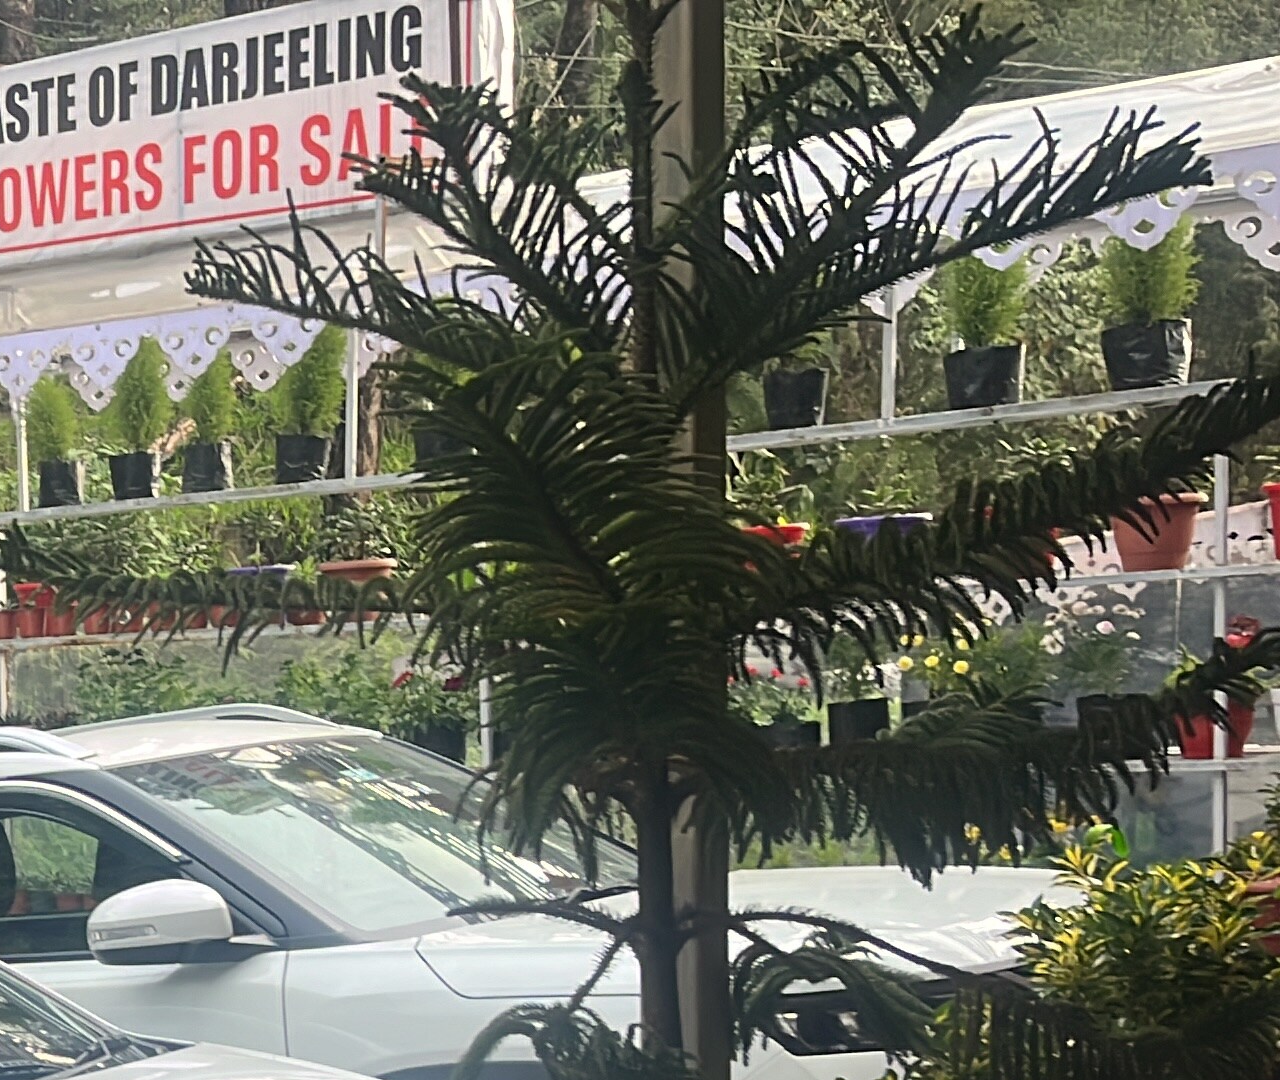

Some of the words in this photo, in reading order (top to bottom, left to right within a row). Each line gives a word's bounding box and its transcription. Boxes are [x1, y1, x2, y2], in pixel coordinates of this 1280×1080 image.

[88, 60, 138, 128] OF
[150, 5, 422, 117] DARJEELING
[183, 124, 279, 205] FOR
[299, 93, 432, 187] SAL
